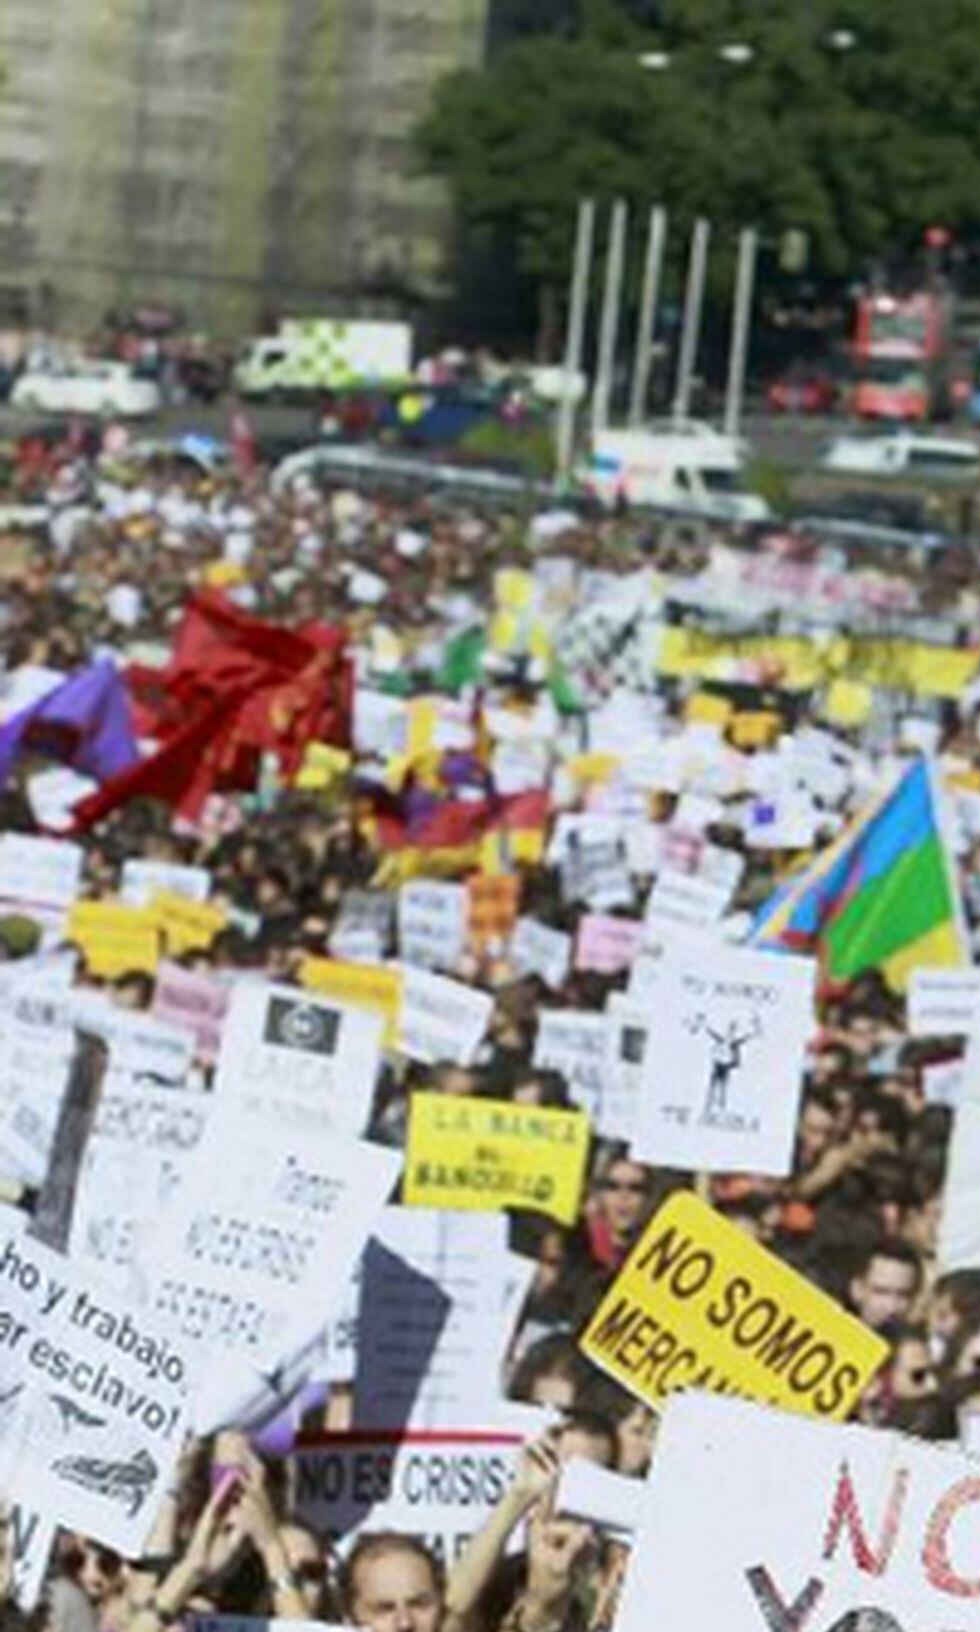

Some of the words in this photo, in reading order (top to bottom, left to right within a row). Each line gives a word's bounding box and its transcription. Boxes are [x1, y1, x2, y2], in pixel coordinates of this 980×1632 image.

[41, 1280, 67, 1316] y
[637, 1226, 714, 1300] NO
[706, 1277, 859, 1414] SOMOS
[299, 1455, 344, 1499] NO
[351, 1458, 393, 1502] ES
